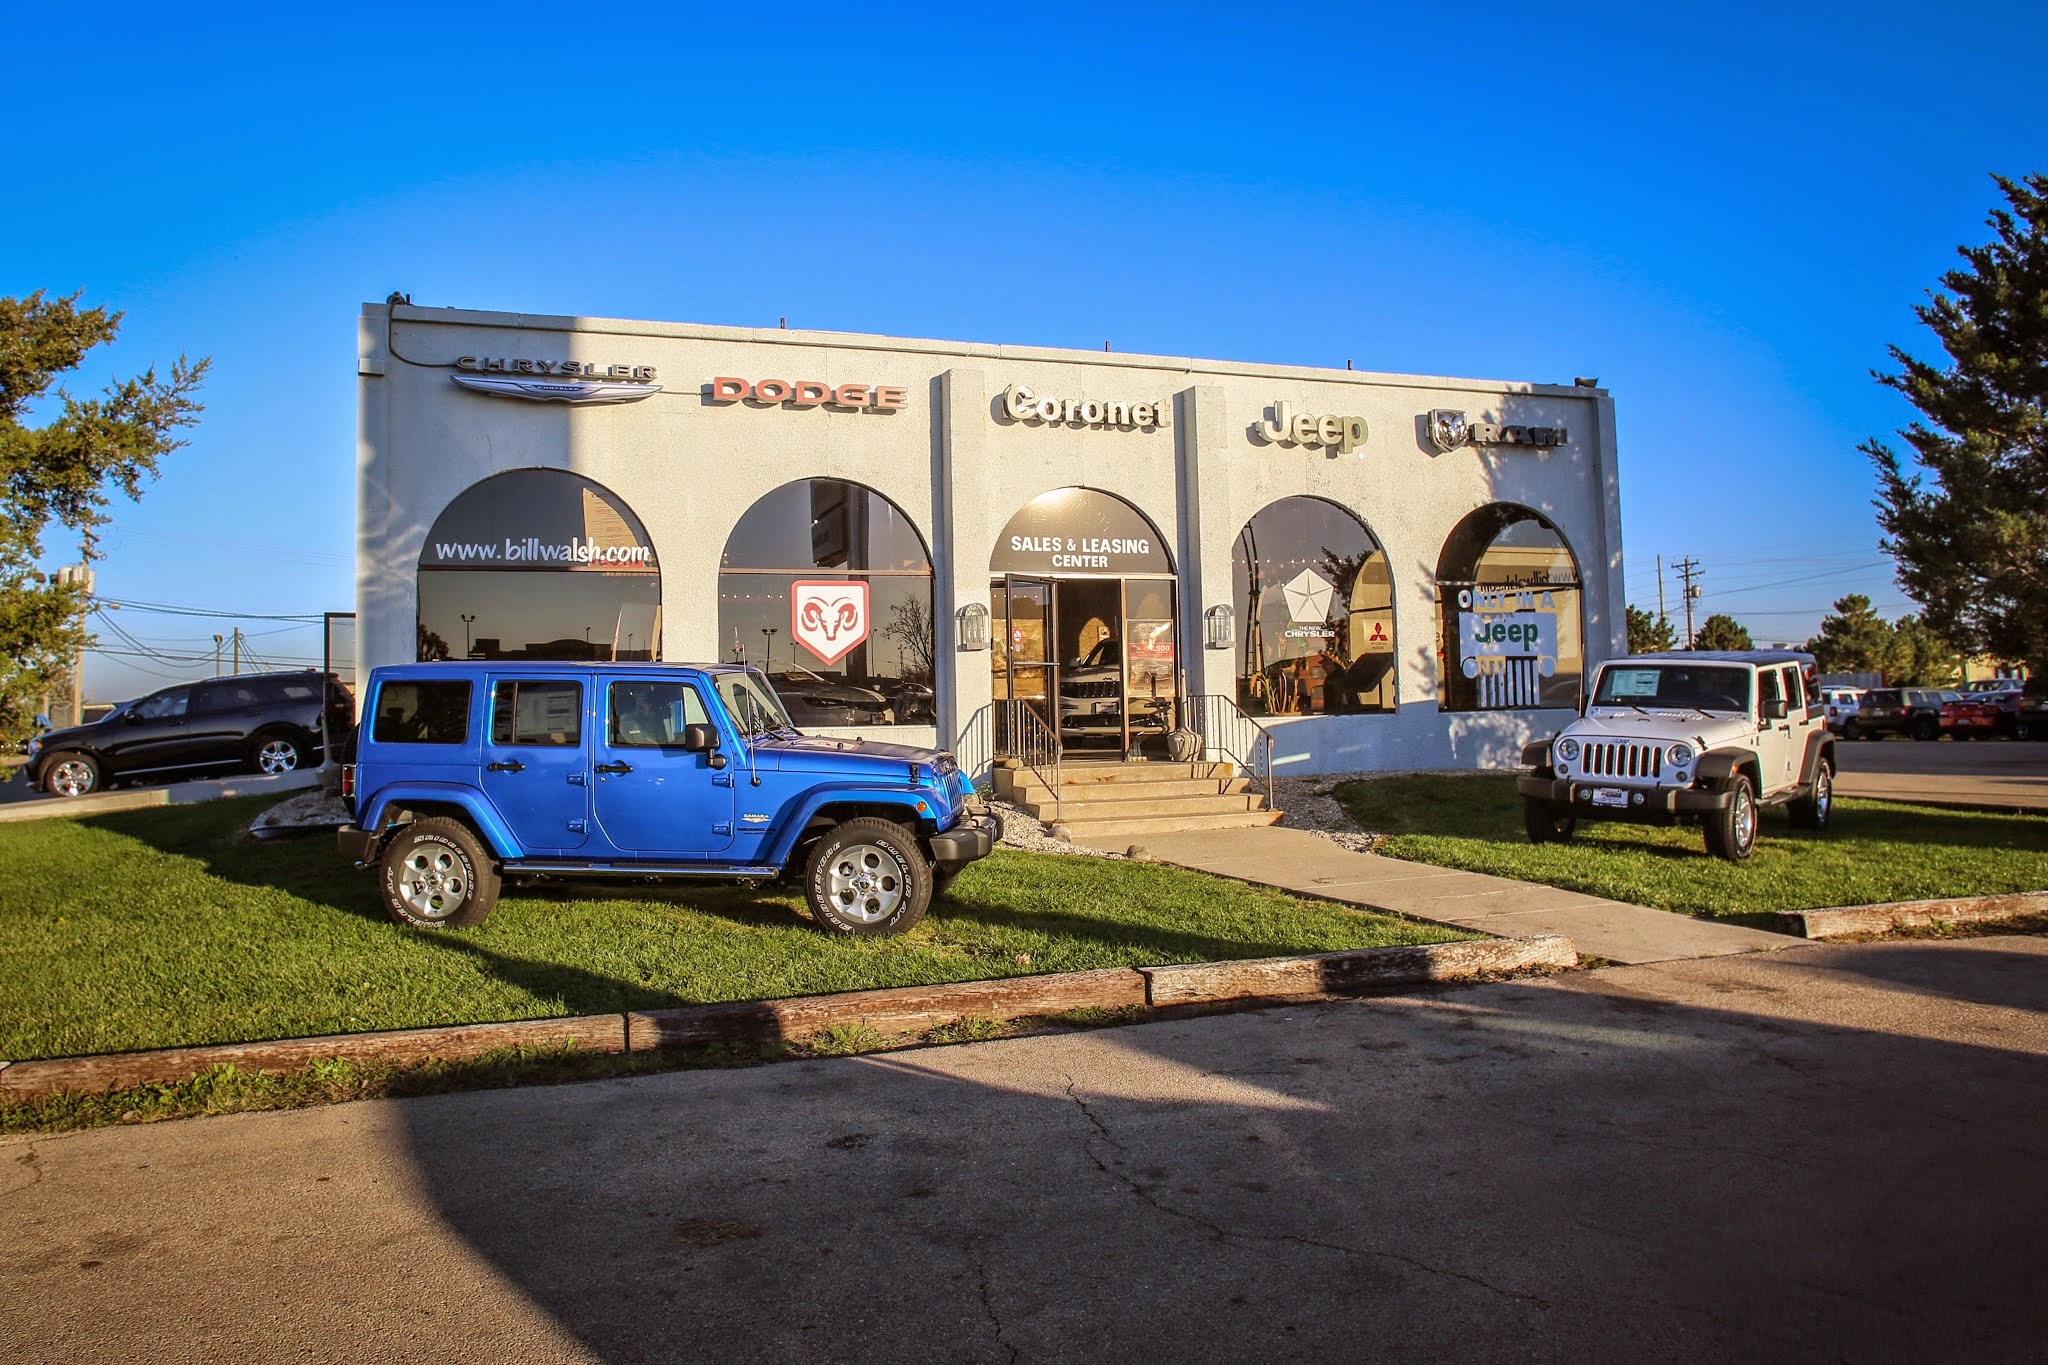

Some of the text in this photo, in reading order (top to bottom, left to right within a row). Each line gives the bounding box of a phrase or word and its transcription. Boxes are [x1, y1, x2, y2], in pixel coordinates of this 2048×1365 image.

[456, 356, 658, 379] CHRYSLER
[713, 376, 908, 410] DODGE
[1003, 385, 1171, 427] Coronet
[1256, 400, 1369, 454] Jeep
[1470, 422, 1568, 446] RAM
[435, 536, 650, 562] www.billwalsh.com
[1011, 535, 1150, 554] SALES & LEASING
[1052, 554, 1109, 568] CENTER
[1457, 590, 1555, 609] ONLY IN A
[1284, 630, 1336, 638] CHRYSLER
[1475, 623, 1539, 652] Jeep
